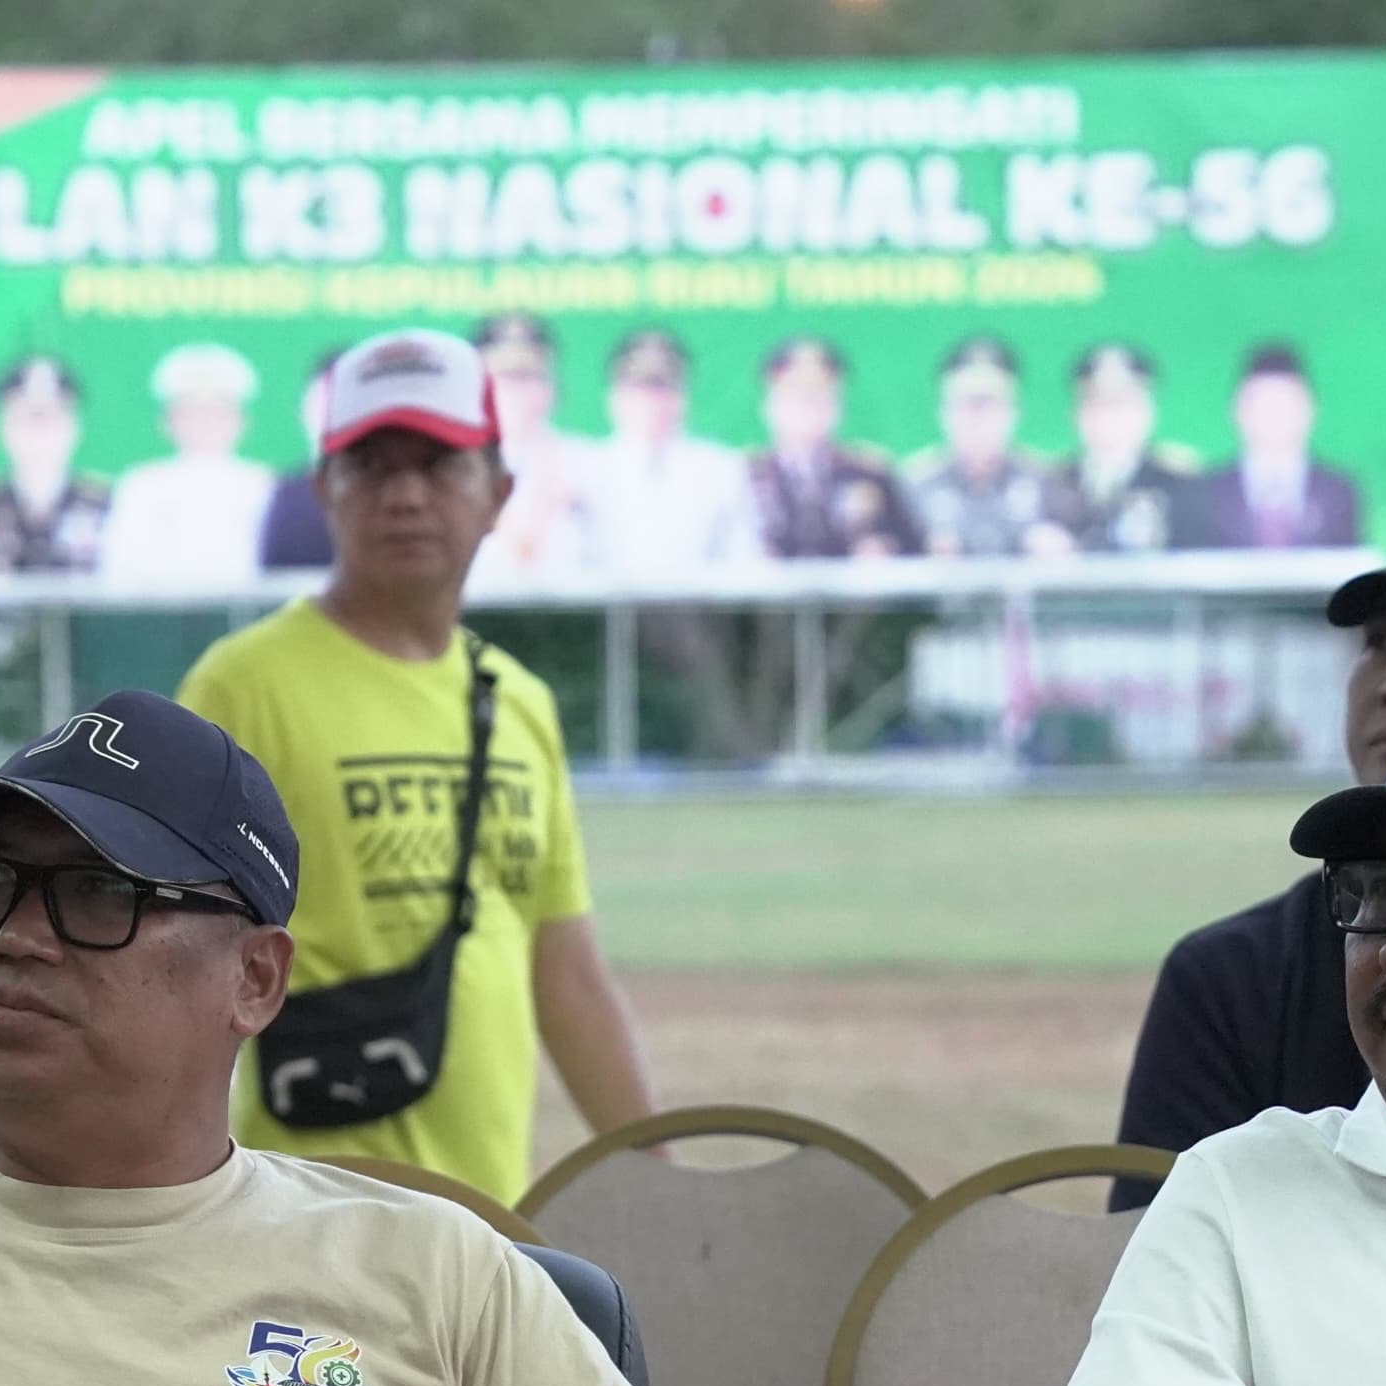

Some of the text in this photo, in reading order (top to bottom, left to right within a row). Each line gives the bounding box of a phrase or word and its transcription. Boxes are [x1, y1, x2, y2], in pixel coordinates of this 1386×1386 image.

[82, 84, 1082, 160] APEL BERSAMA MEMPERINGATI
[239, 161, 385, 262] K3
[402, 154, 991, 261] NASIONAL
[1005, 146, 1334, 251] KE-56
